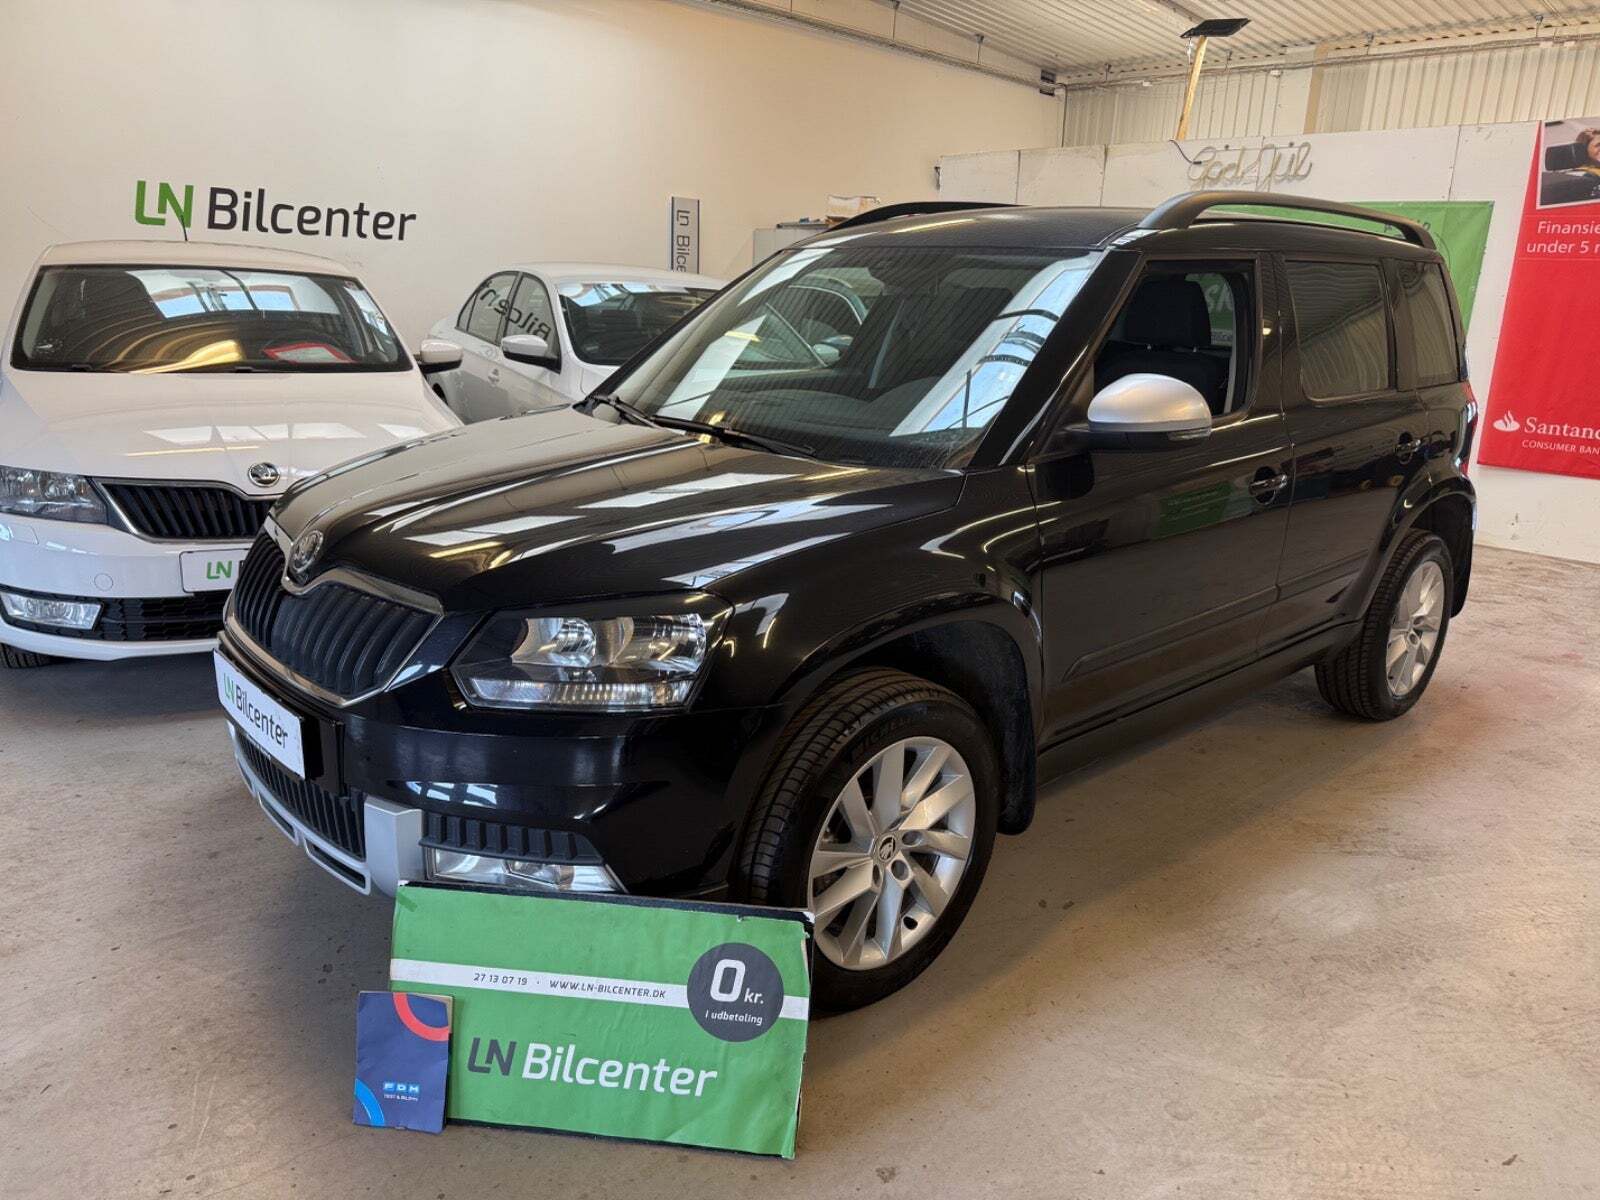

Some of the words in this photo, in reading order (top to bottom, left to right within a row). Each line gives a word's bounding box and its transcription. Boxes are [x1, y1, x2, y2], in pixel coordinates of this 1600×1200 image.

[134, 180, 194, 229] LN
[207, 186, 417, 241] Bilcenter
[1537, 220, 1600, 234] Finansie
[1526, 240, 1575, 254] under
[1579, 240, 1590, 254] 5
[1522, 440, 1576, 453] CONSUMER
[207, 561, 232, 579] LN
[223, 673, 235, 704] LN
[236, 684, 288, 749] Bilcenter
[474, 972, 485, 983] 27
[489, 974, 498, 984] 13
[502, 975, 514, 985] 07
[518, 976, 528, 986] 19
[549, 979, 667, 999] WWW.LN-BILCENTER.DK
[710, 958, 746, 1003] 0
[744, 987, 764, 1005] kr.
[711, 1011, 763, 1026] udbetaling
[467, 1037, 517, 1077] LN
[521, 1042, 718, 1097] Bilcenter
